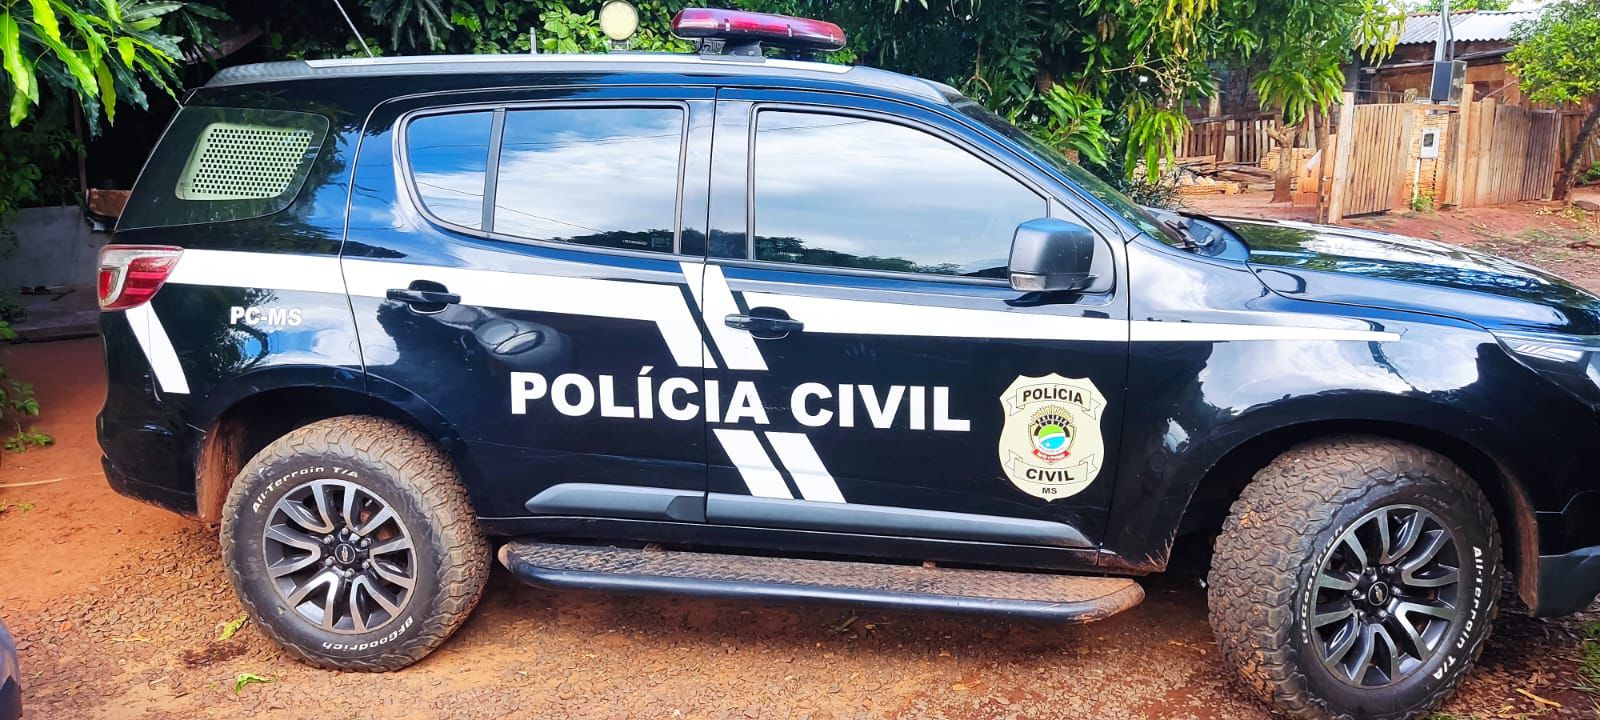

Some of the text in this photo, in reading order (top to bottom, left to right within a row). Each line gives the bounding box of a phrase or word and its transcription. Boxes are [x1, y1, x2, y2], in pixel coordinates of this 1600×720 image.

[230, 306, 302, 326] PC-MS
[509, 366, 971, 432] POLÍCIA CIVIL
[1023, 386, 1083, 405] POLÍCIA
[1026, 468, 1075, 482] CIVIL
[252, 466, 359, 514] All-Terrain T/A
[1042, 487, 1057, 495] MS
[322, 615, 414, 651] BFGoodrich
